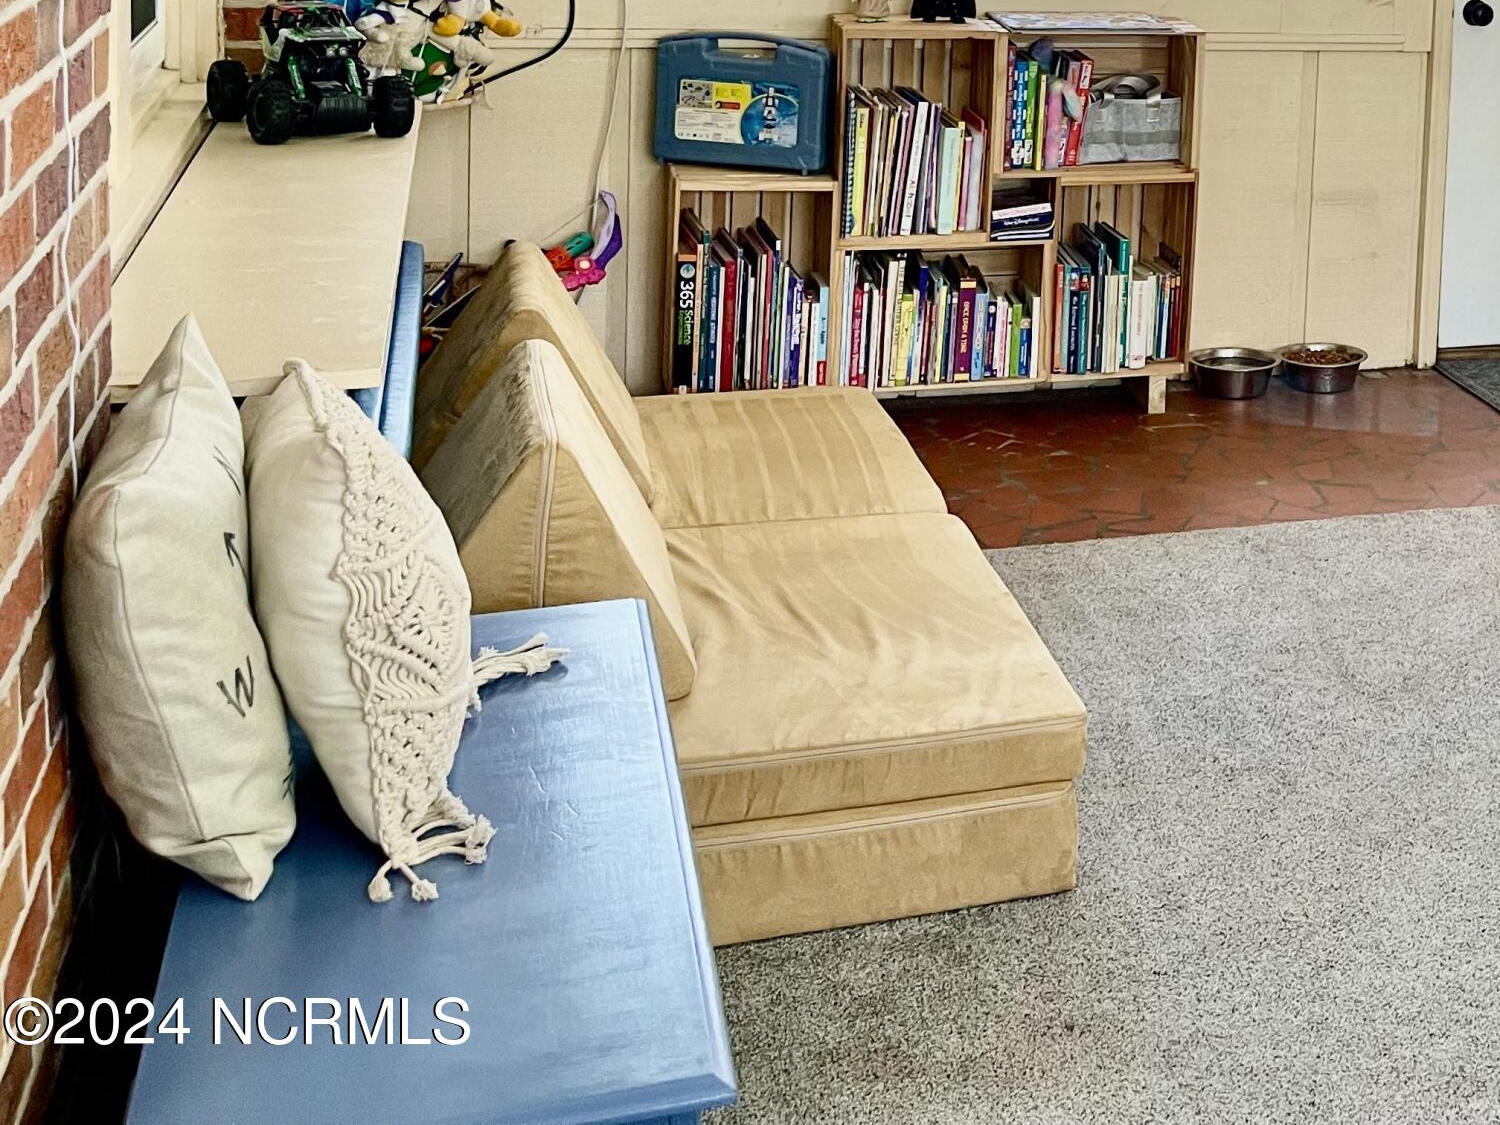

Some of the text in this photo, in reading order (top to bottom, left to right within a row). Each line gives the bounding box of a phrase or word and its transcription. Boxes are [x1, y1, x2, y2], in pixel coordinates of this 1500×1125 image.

[679, 280, 694, 346] 365 Science
[962, 301, 970, 317] ONCE
[961, 317, 969, 333] UPON
[960, 339, 968, 354] TIME
[216, 655, 256, 718] W
